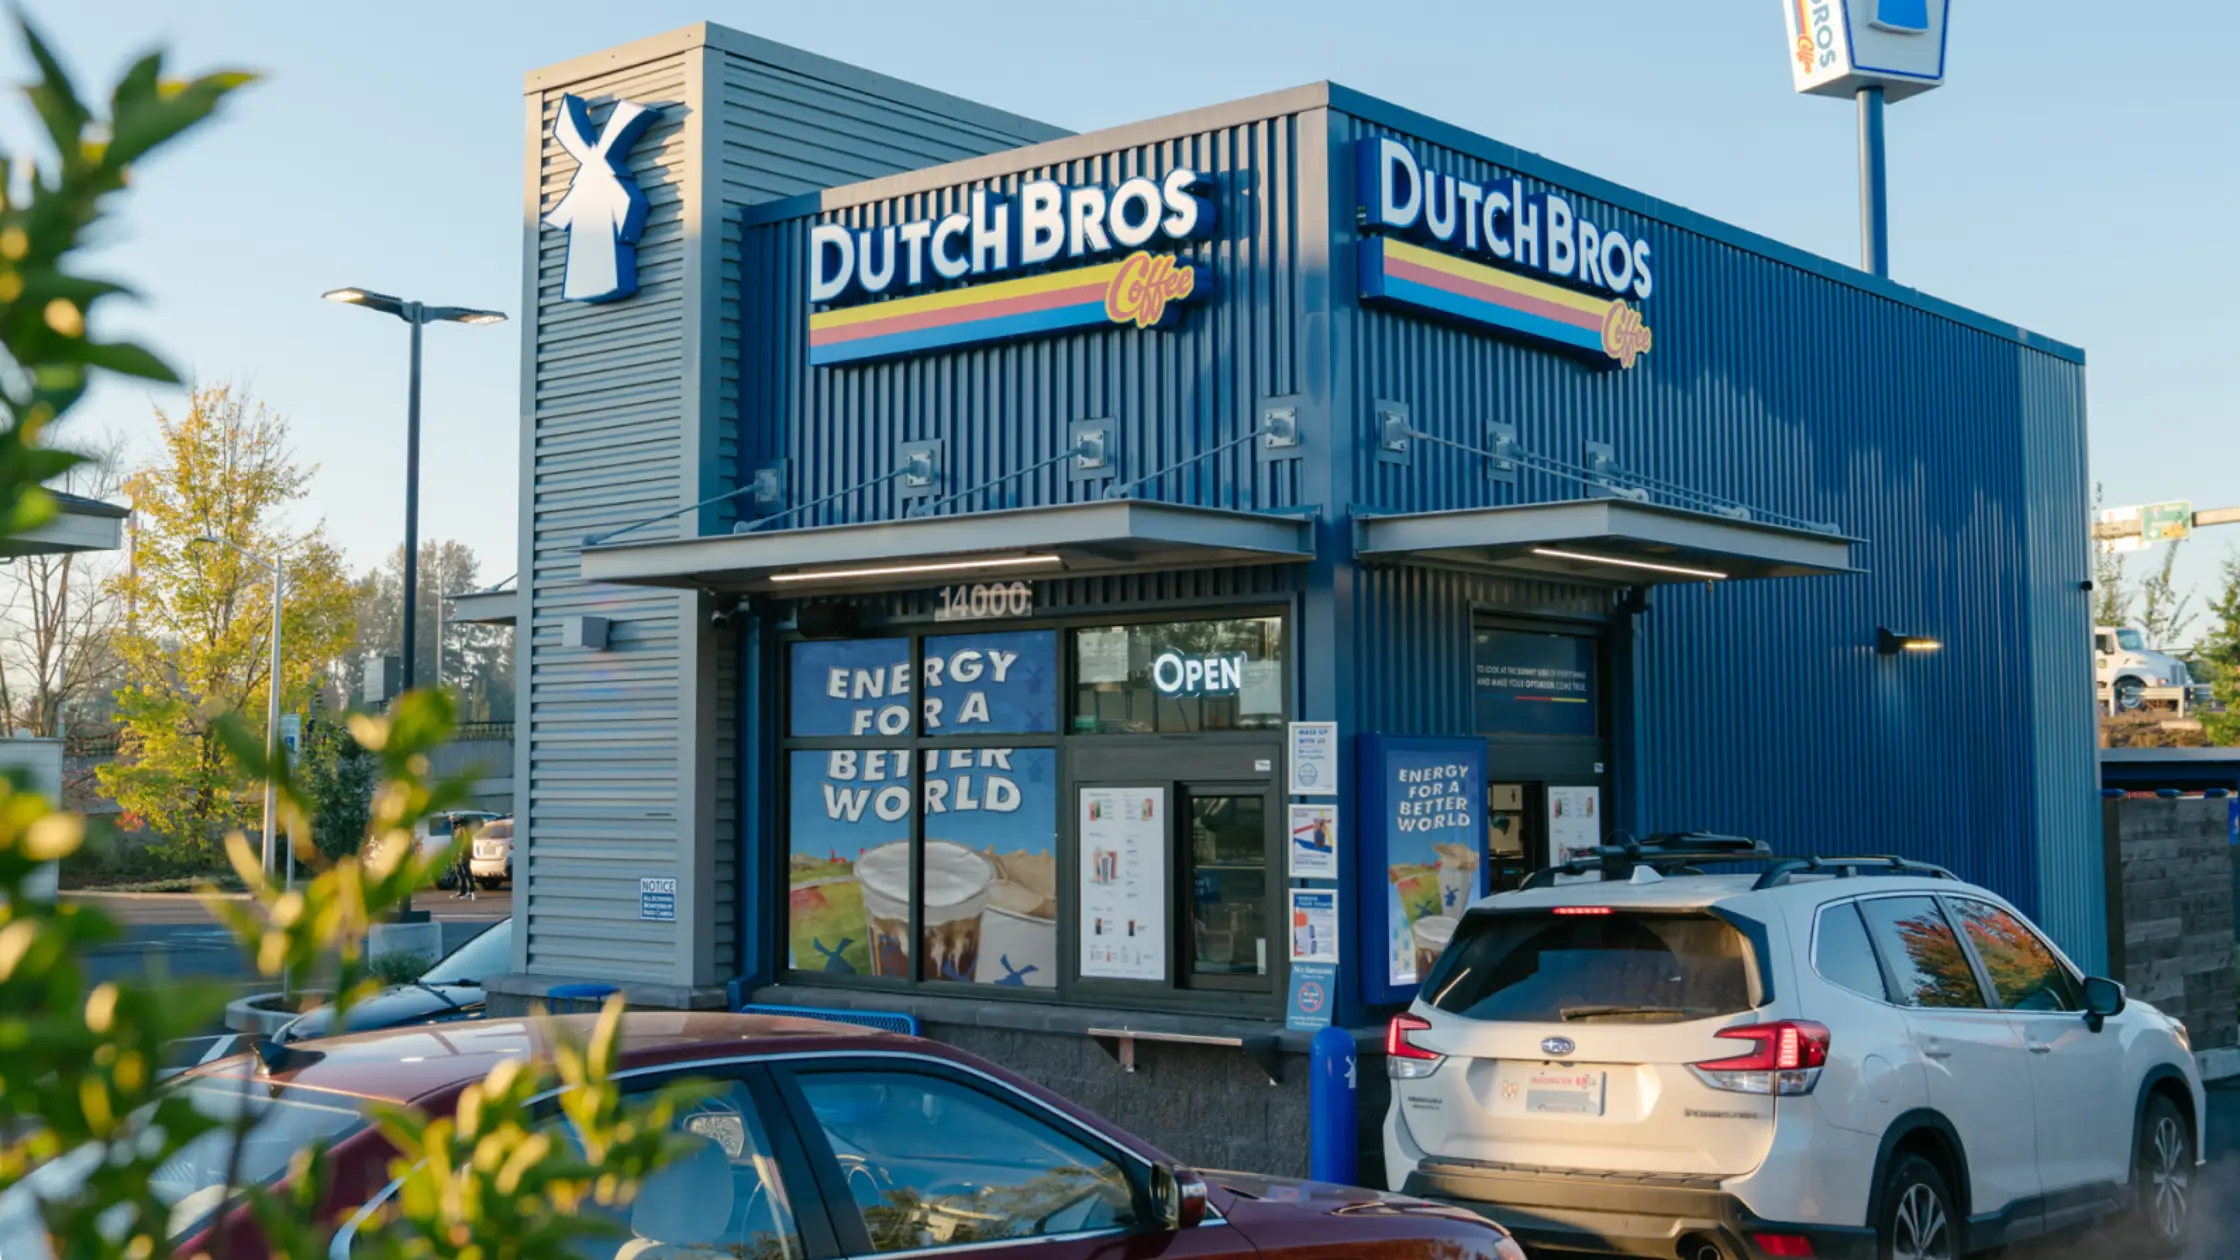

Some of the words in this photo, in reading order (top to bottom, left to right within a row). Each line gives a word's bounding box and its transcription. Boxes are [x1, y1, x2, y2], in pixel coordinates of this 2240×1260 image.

[1812, 0, 1836, 68] ROS
[809, 188, 1008, 303] DUTCH
[1021, 168, 1198, 264] BROS
[1380, 137, 1539, 269] DUTCH
[1547, 193, 1652, 299] BROS
[1105, 250, 1195, 328] Coffee
[1602, 298, 1651, 369] Coffee
[939, 582, 1026, 618] 14000
[827, 649, 1018, 699] ENERGY
[1153, 652, 1240, 692] OPEN
[852, 697, 943, 736] FOR
[957, 691, 990, 723] A
[1399, 764, 1468, 782] ENERGY
[1408, 783, 1443, 799] FOR
[1448, 780, 1459, 793] A
[822, 775, 1022, 823] WORLD
[1400, 796, 1468, 816] BETTER
[1397, 813, 1470, 832] WORLD
[642, 880, 674, 892] NOTICE
